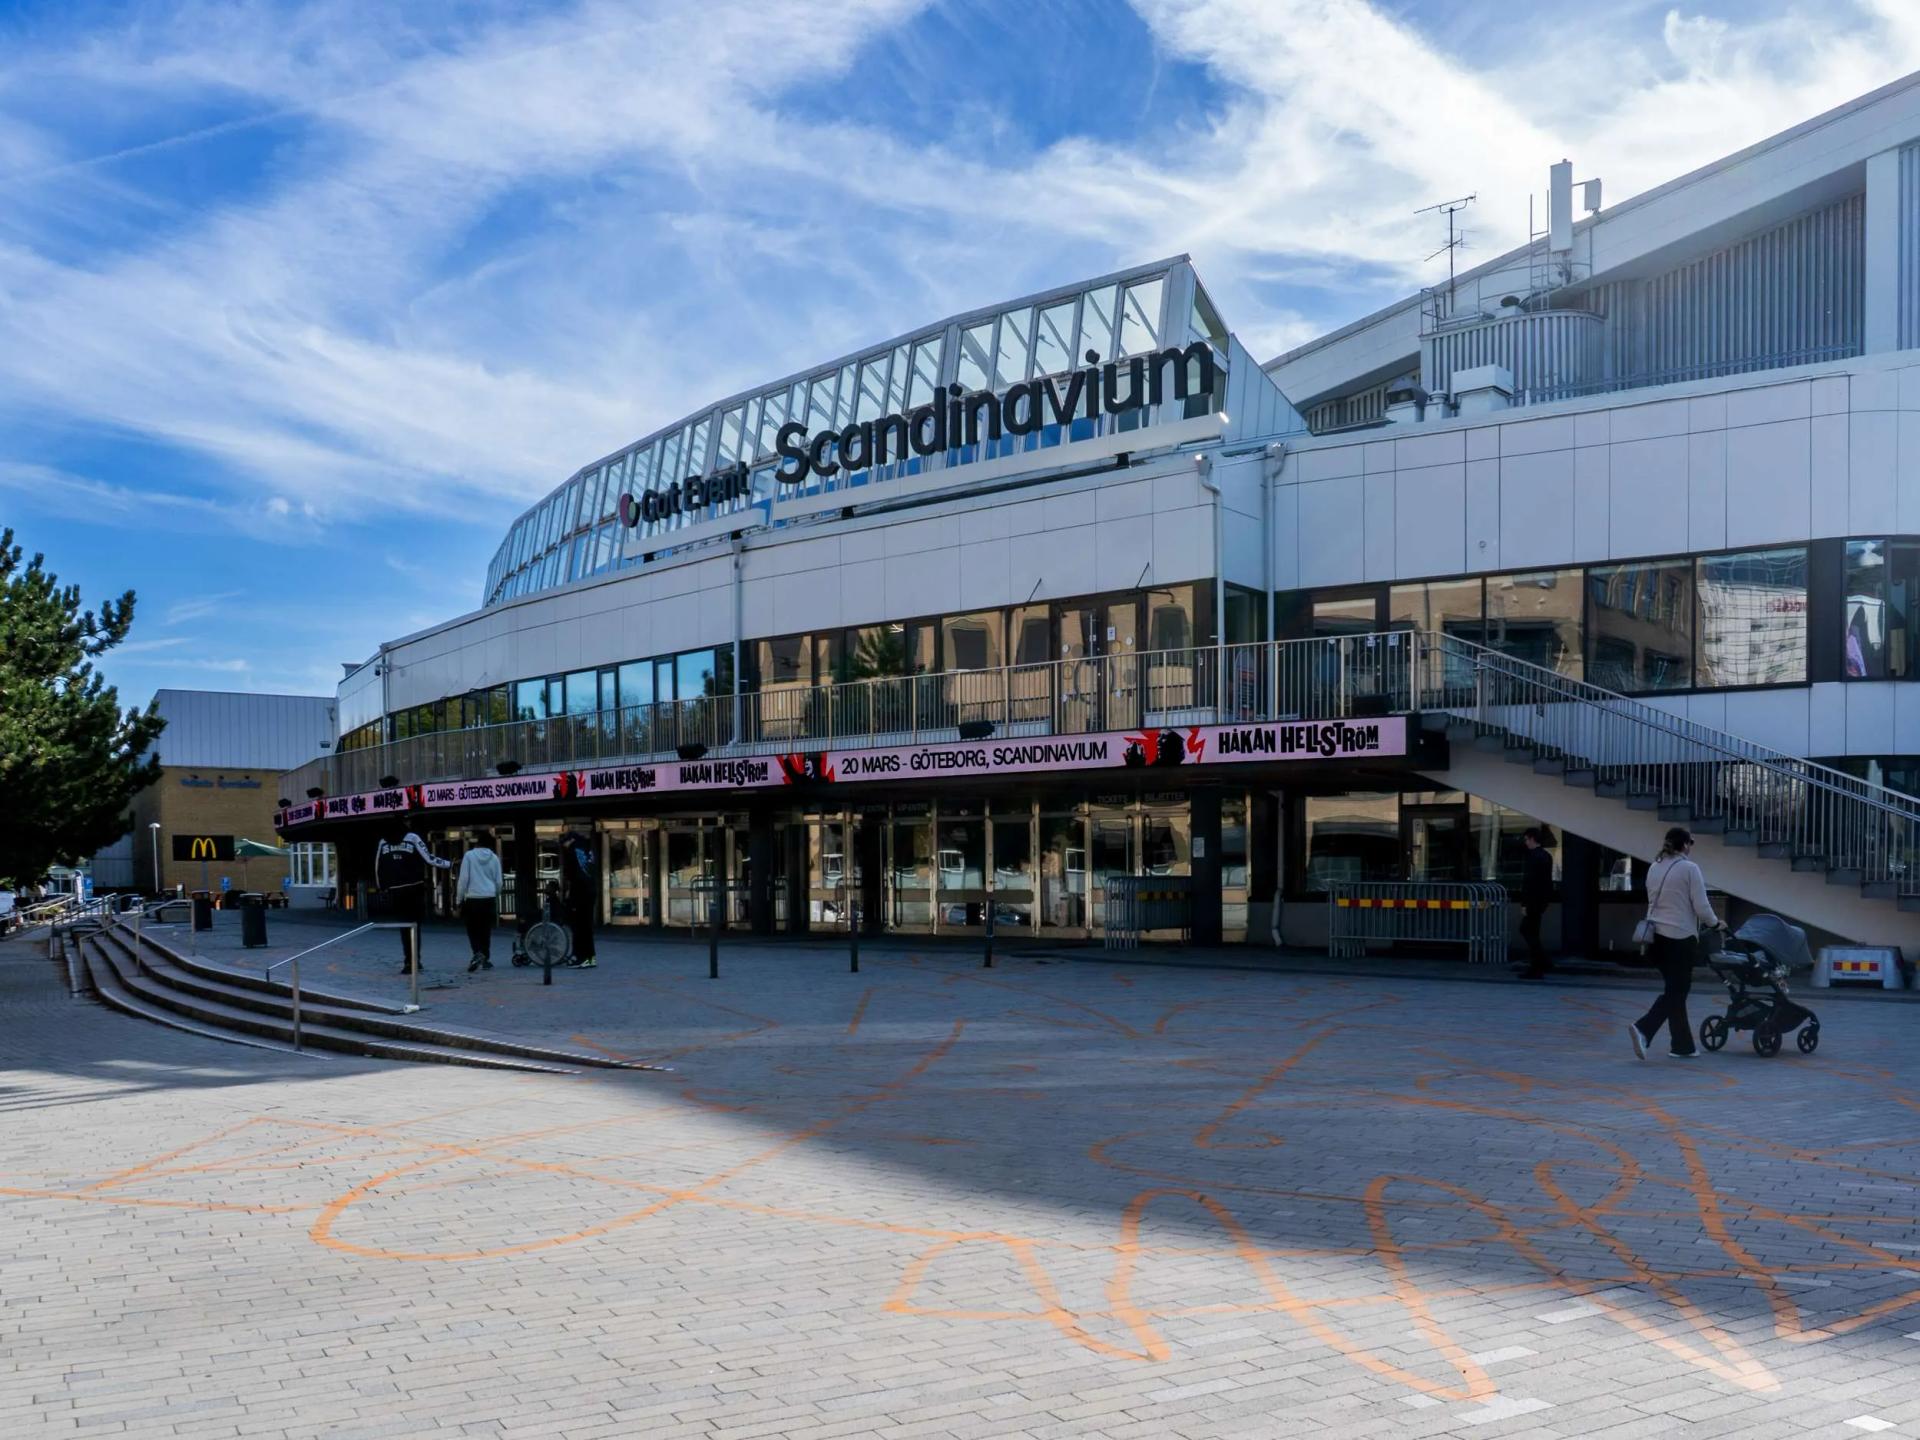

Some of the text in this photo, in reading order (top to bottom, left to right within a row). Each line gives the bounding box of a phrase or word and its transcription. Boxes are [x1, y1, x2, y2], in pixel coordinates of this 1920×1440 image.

[775, 341, 1214, 484] Scandinavium
[642, 461, 750, 522] Got Event
[1219, 722, 1379, 757] HÅKAN HELLSTRÖM
[680, 760, 768, 786] HÅKAN HELLSTRÖM
[842, 758, 859, 775] 20
[862, 755, 900, 773] MARS
[910, 749, 990, 771] GÖTEBORG,
[993, 741, 1108, 766] SCANDINAVIUM
[427, 790, 436, 802] 20
[437, 788, 455, 801] MARS
[495, 781, 547, 797] SCANDINAVIUM
